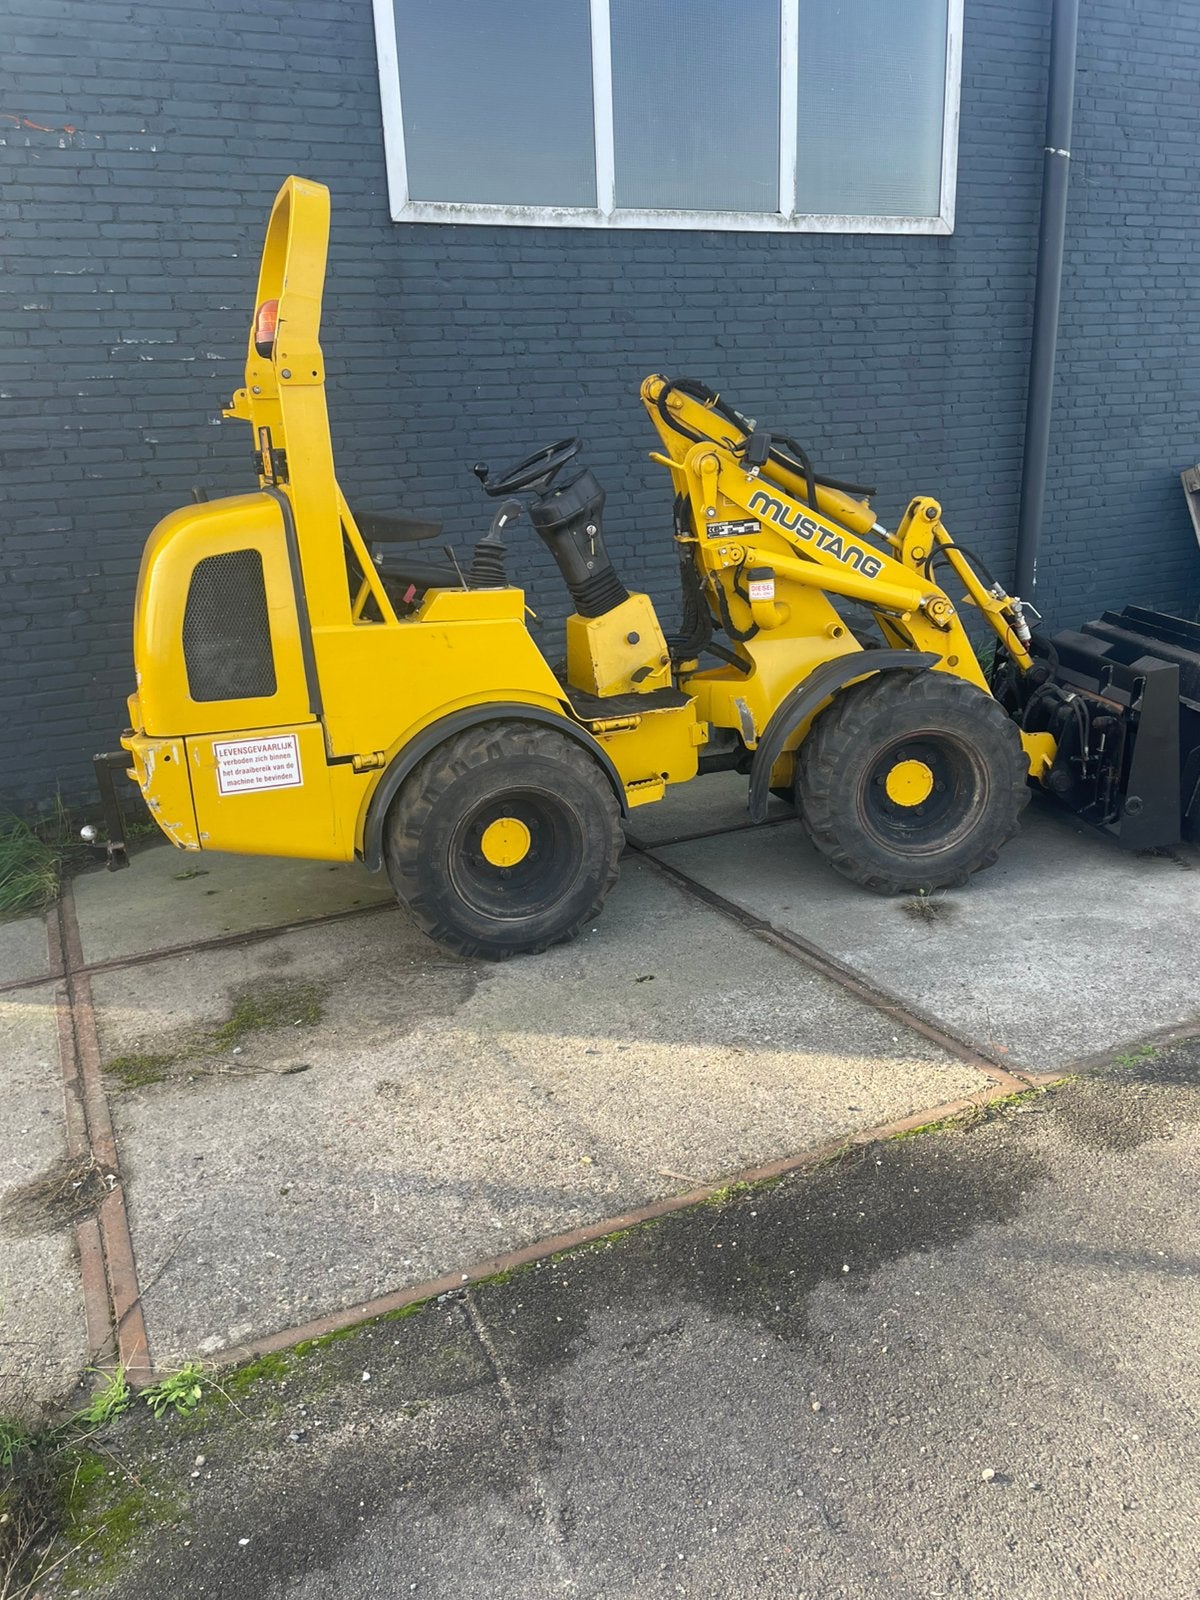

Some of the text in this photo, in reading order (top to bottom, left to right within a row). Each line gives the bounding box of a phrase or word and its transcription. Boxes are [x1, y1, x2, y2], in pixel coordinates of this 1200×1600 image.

[748, 490, 882, 579] MUSTANG
[219, 742, 293, 757] LEVENSGEVAARLIJK
[223, 752, 291, 766] verboden zich binnen
[235, 764, 271, 775] draaibereik
[227, 777, 255, 786] machine
[264, 773, 293, 782] bevinden
